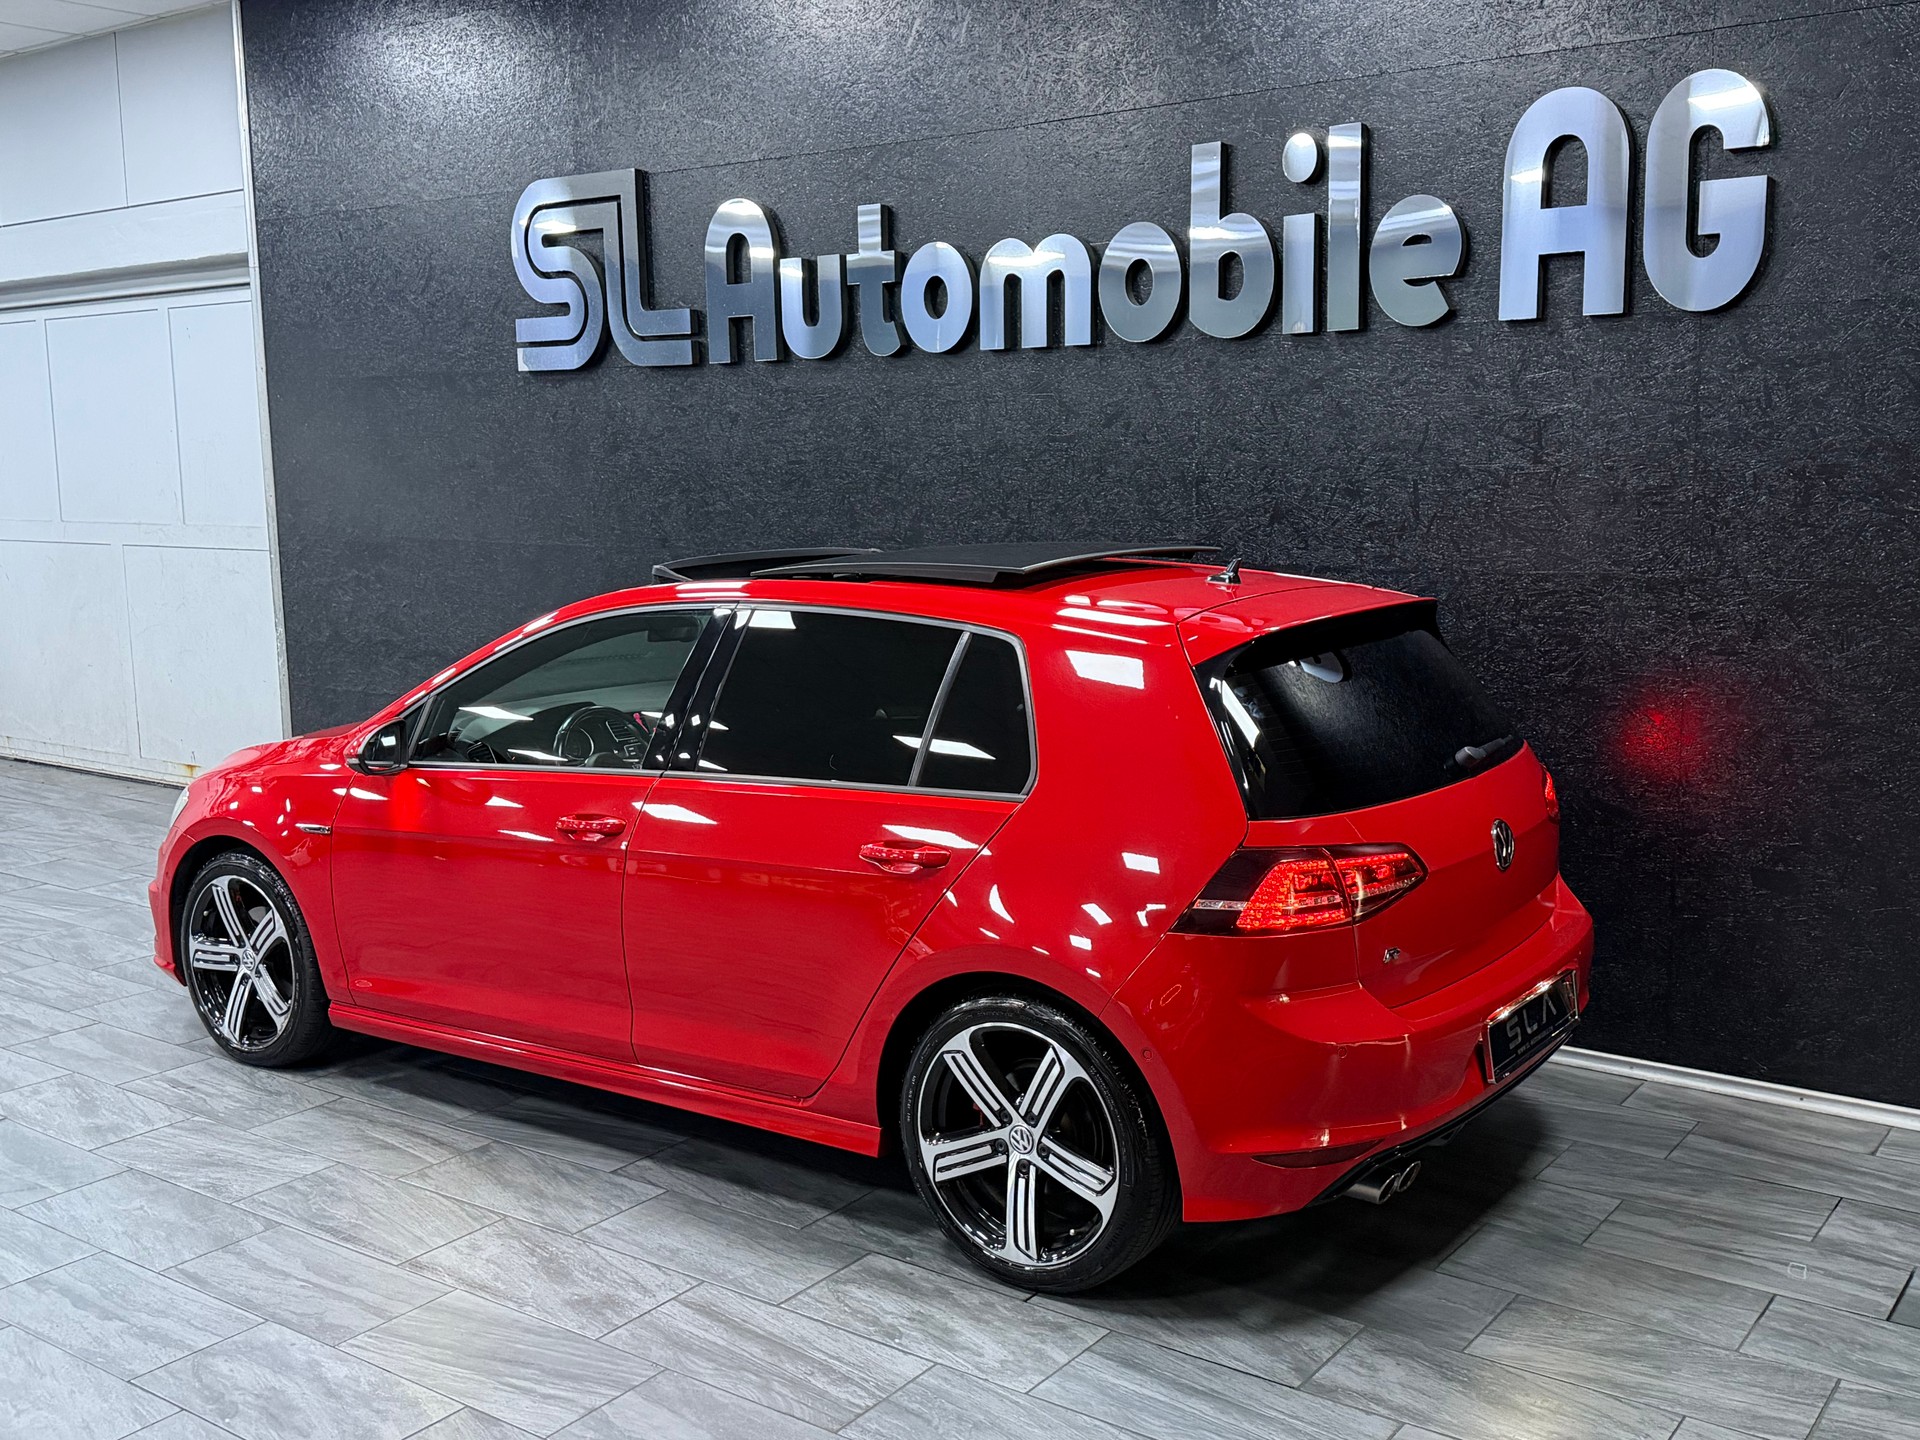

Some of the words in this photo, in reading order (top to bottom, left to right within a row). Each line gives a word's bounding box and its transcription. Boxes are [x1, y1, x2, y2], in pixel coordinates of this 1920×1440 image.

[510, 168, 694, 372] SL
[705, 121, 1466, 364] Automobile
[1498, 68, 1771, 322] AG
[1009, 1125, 1034, 1154] VW
